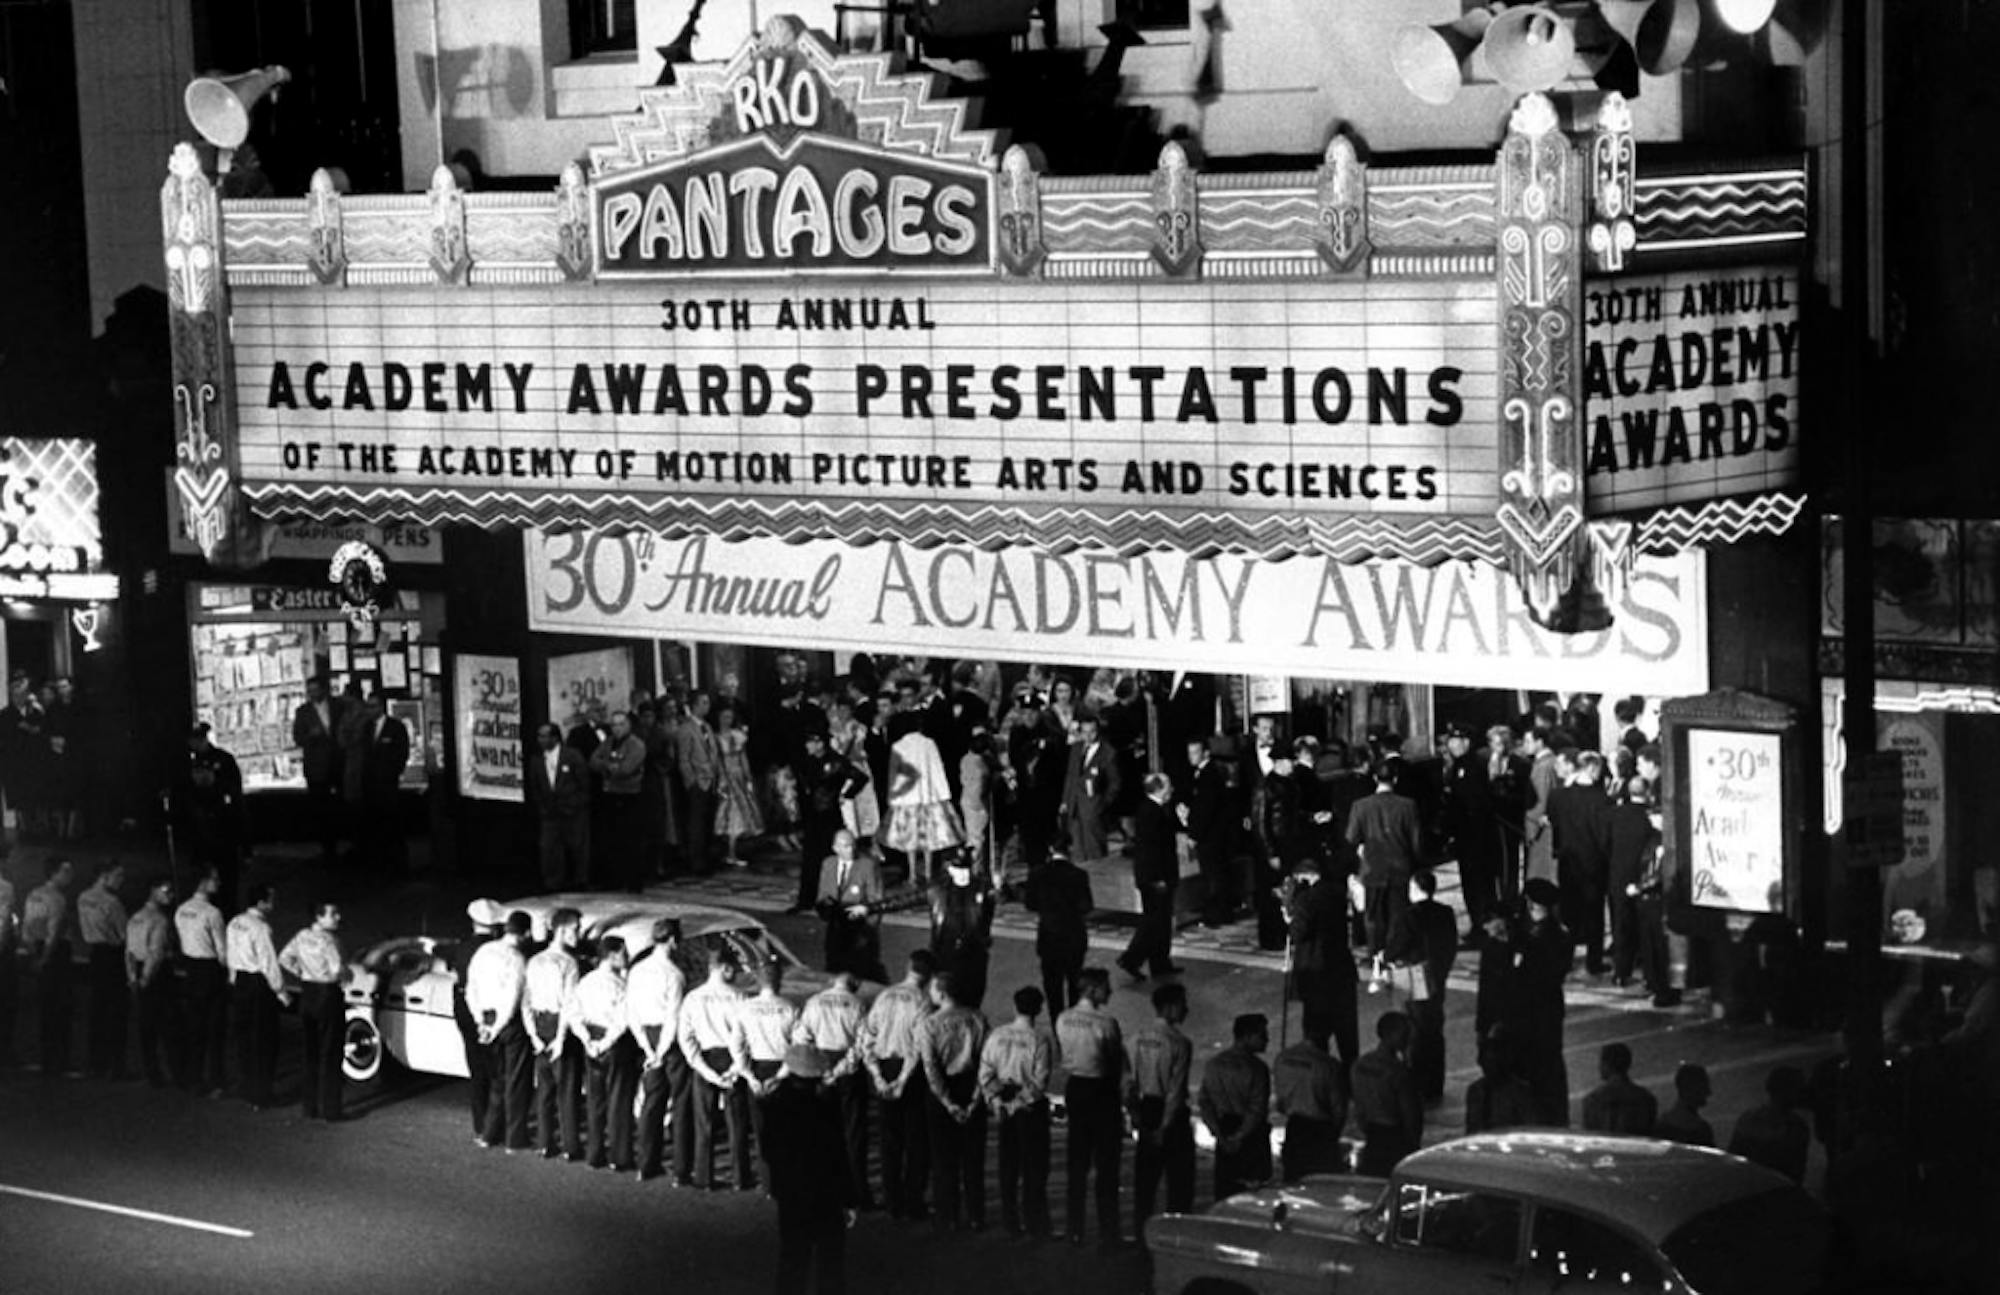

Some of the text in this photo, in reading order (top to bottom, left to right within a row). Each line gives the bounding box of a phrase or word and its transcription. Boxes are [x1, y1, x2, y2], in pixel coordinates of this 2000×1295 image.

[734, 57, 819, 133] RKO
[604, 165, 976, 259] PANTAGES
[660, 297, 936, 331] 30TH ANNUAL
[1587, 275, 1790, 327] 30TH ANNUAL
[1583, 320, 1800, 400] ACADEMY
[267, 361, 1463, 427] ACADEMY AWARDS PRESENTATIONS
[1586, 393, 1789, 476] AWARDS
[283, 442, 1437, 500] OF THE ACADEMY OF MOTION PICTURE ARTS AND SCIENCES
[383, 527, 430, 547] PENS
[270, 587, 332, 611] Easter
[644, 534, 841, 620] Annual
[870, 543, 1257, 643] ACADEMY
[1718, 747, 1771, 781] 30th
